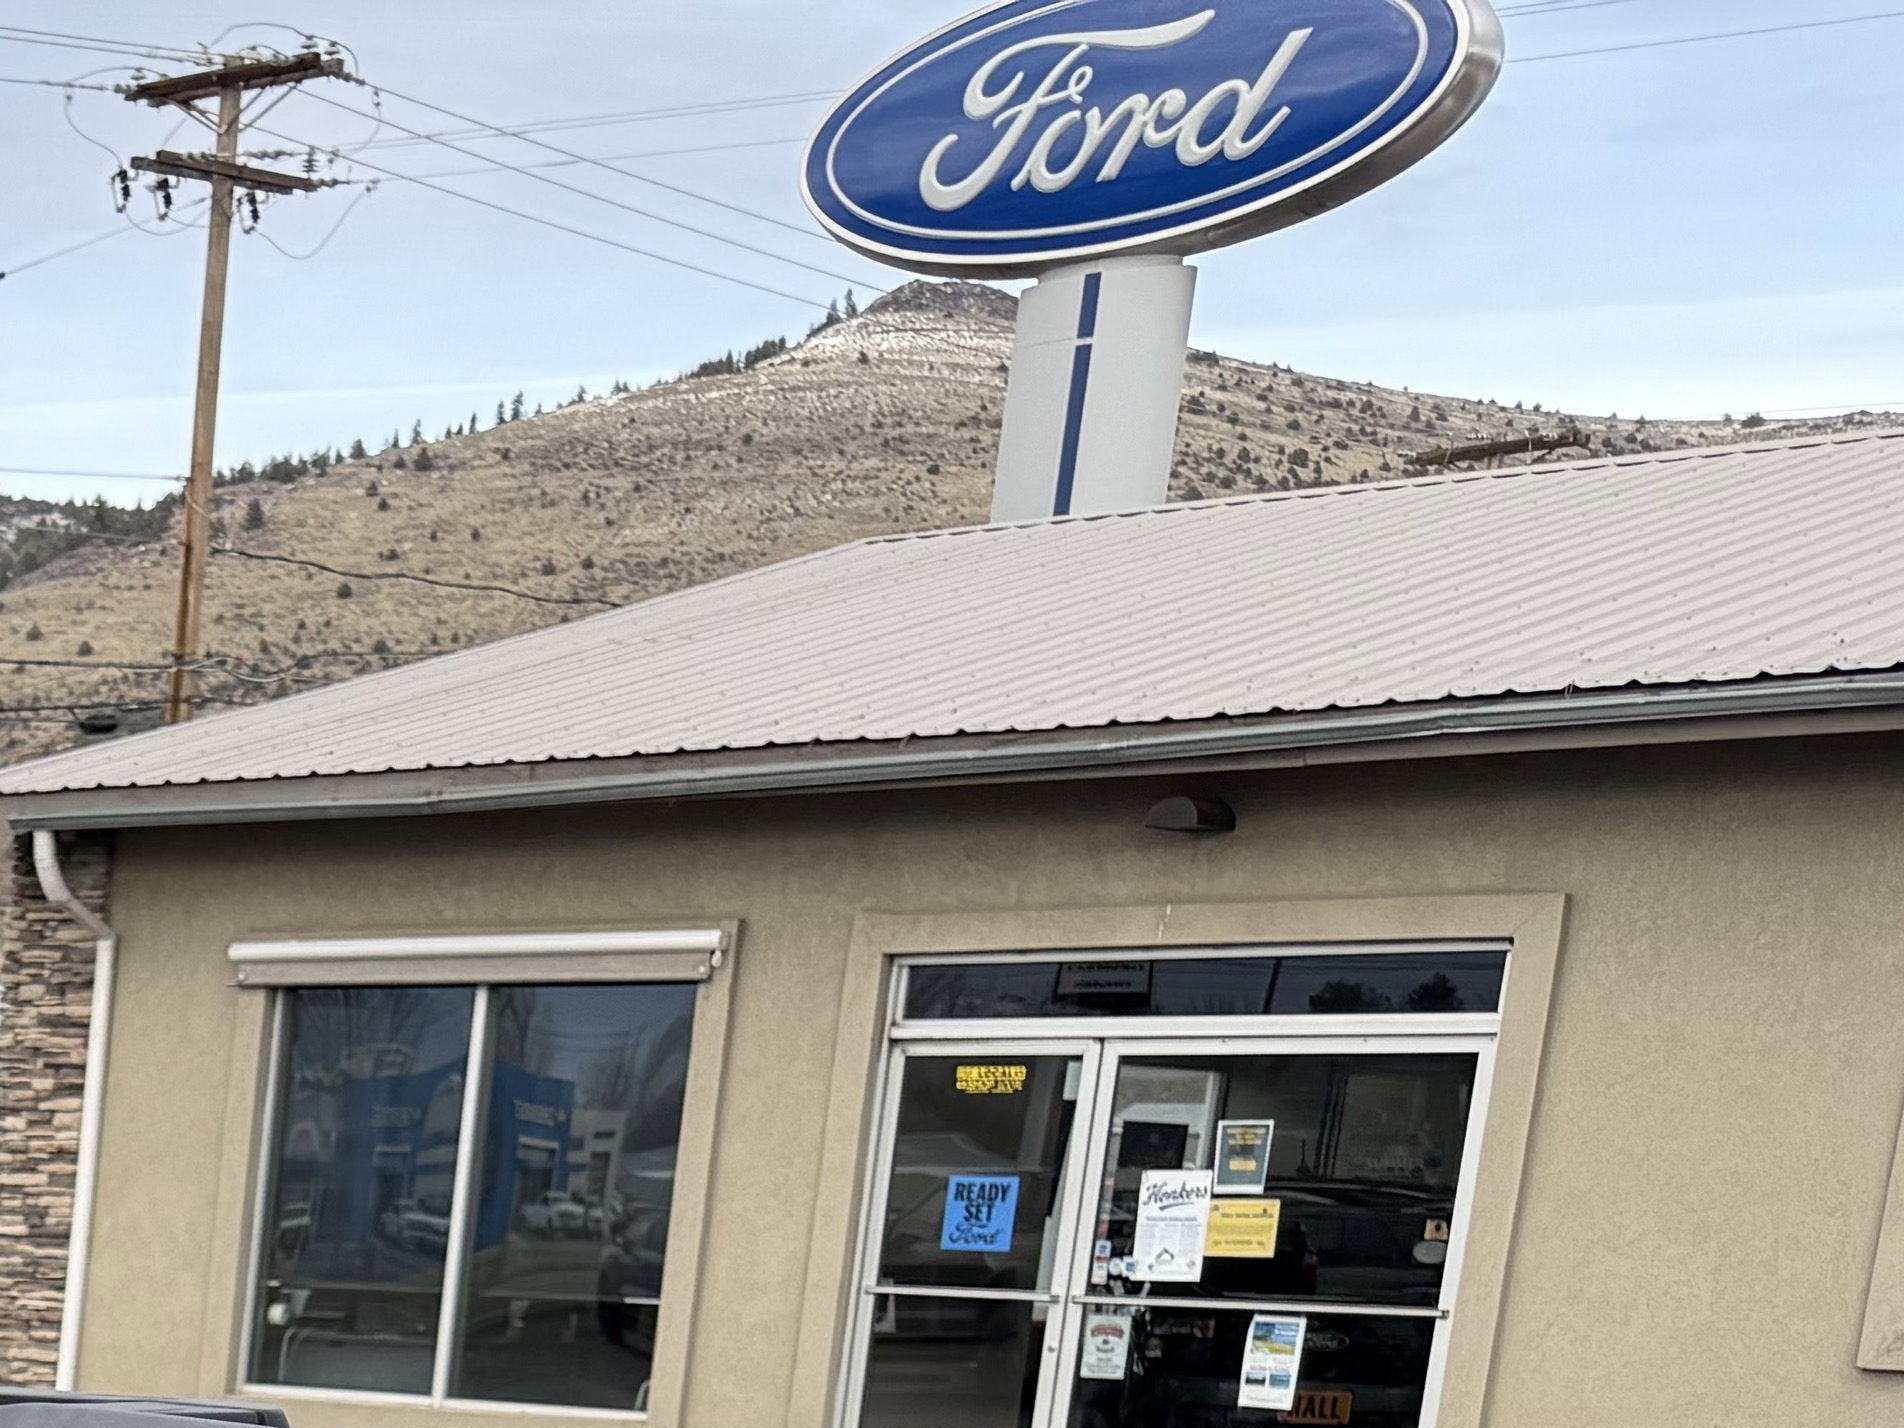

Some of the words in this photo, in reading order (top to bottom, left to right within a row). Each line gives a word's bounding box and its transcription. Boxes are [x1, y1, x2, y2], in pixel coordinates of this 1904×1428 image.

[919, 9, 1314, 212] Ford
[954, 1182, 1012, 1202] READY
[964, 1202, 996, 1223] SET
[948, 1221, 1004, 1246] Ford
